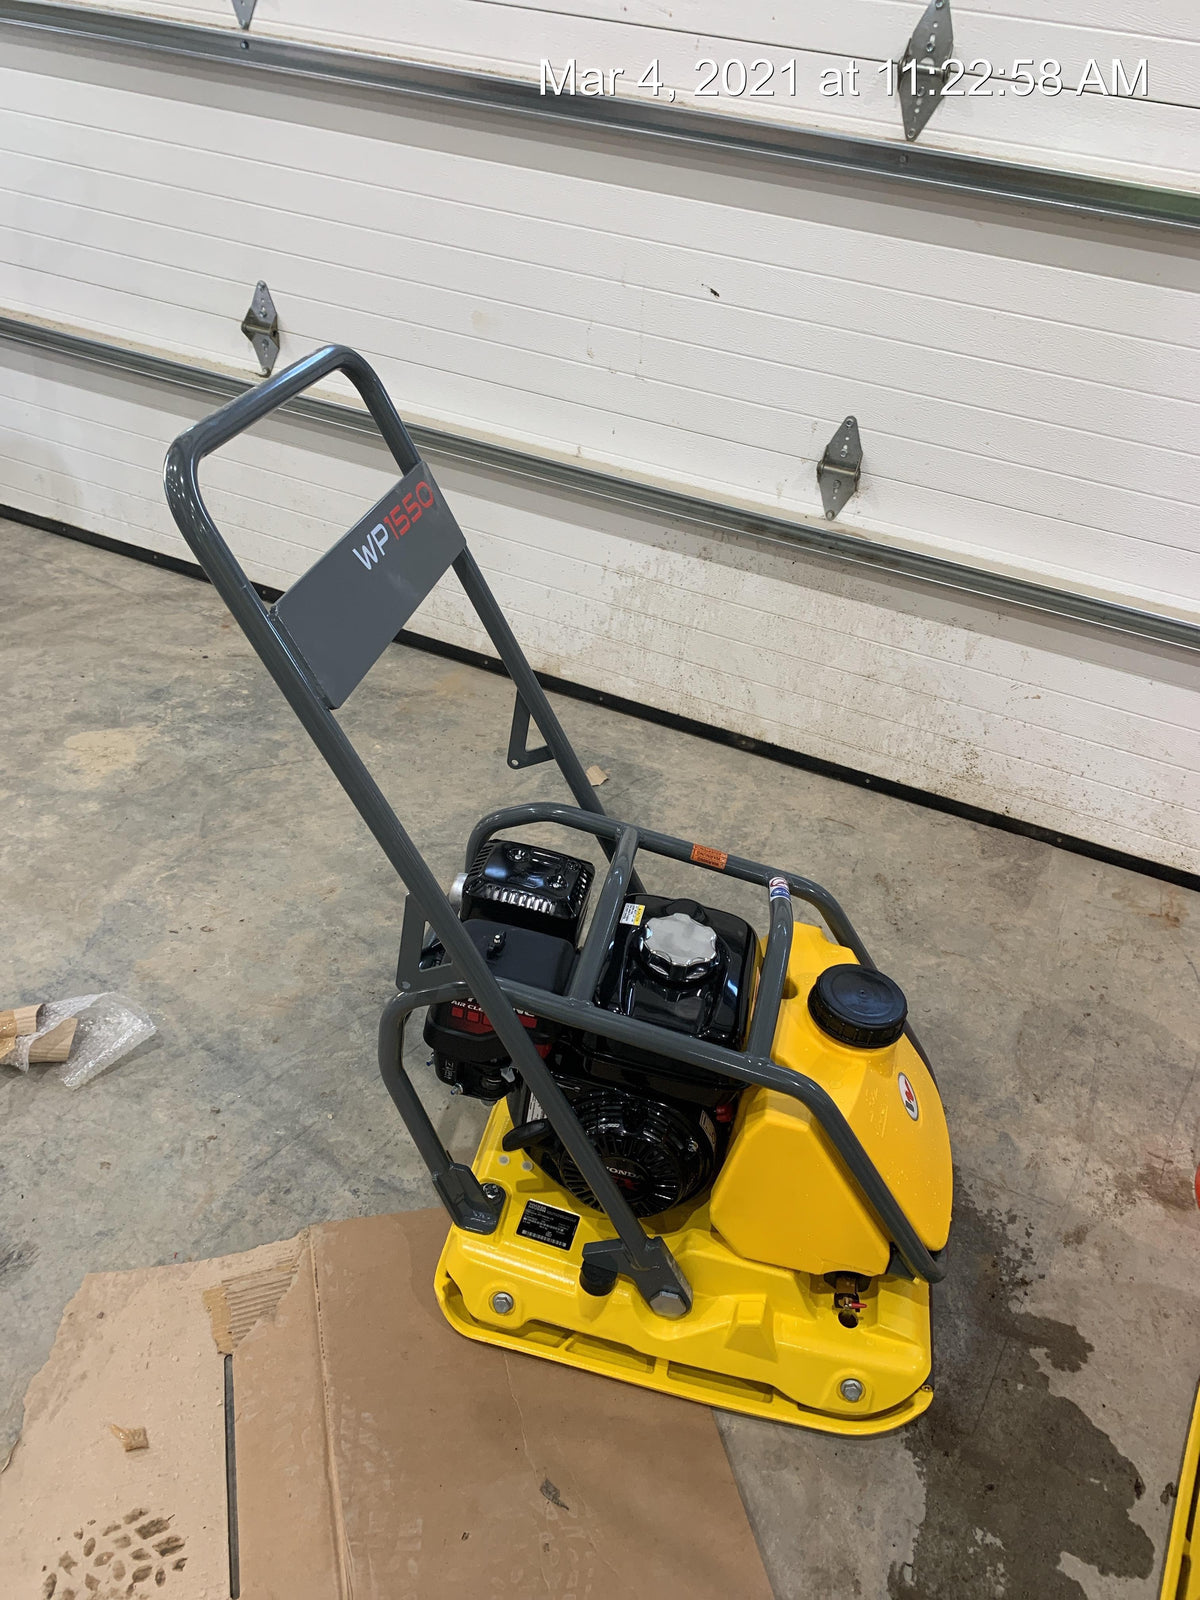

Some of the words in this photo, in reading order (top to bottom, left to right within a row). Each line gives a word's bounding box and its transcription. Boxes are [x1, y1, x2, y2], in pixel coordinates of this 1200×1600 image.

[352, 481, 434, 570] WP1550
[451, 1000, 466, 1008] AIR
[606, 1166, 644, 1179] ONDA
